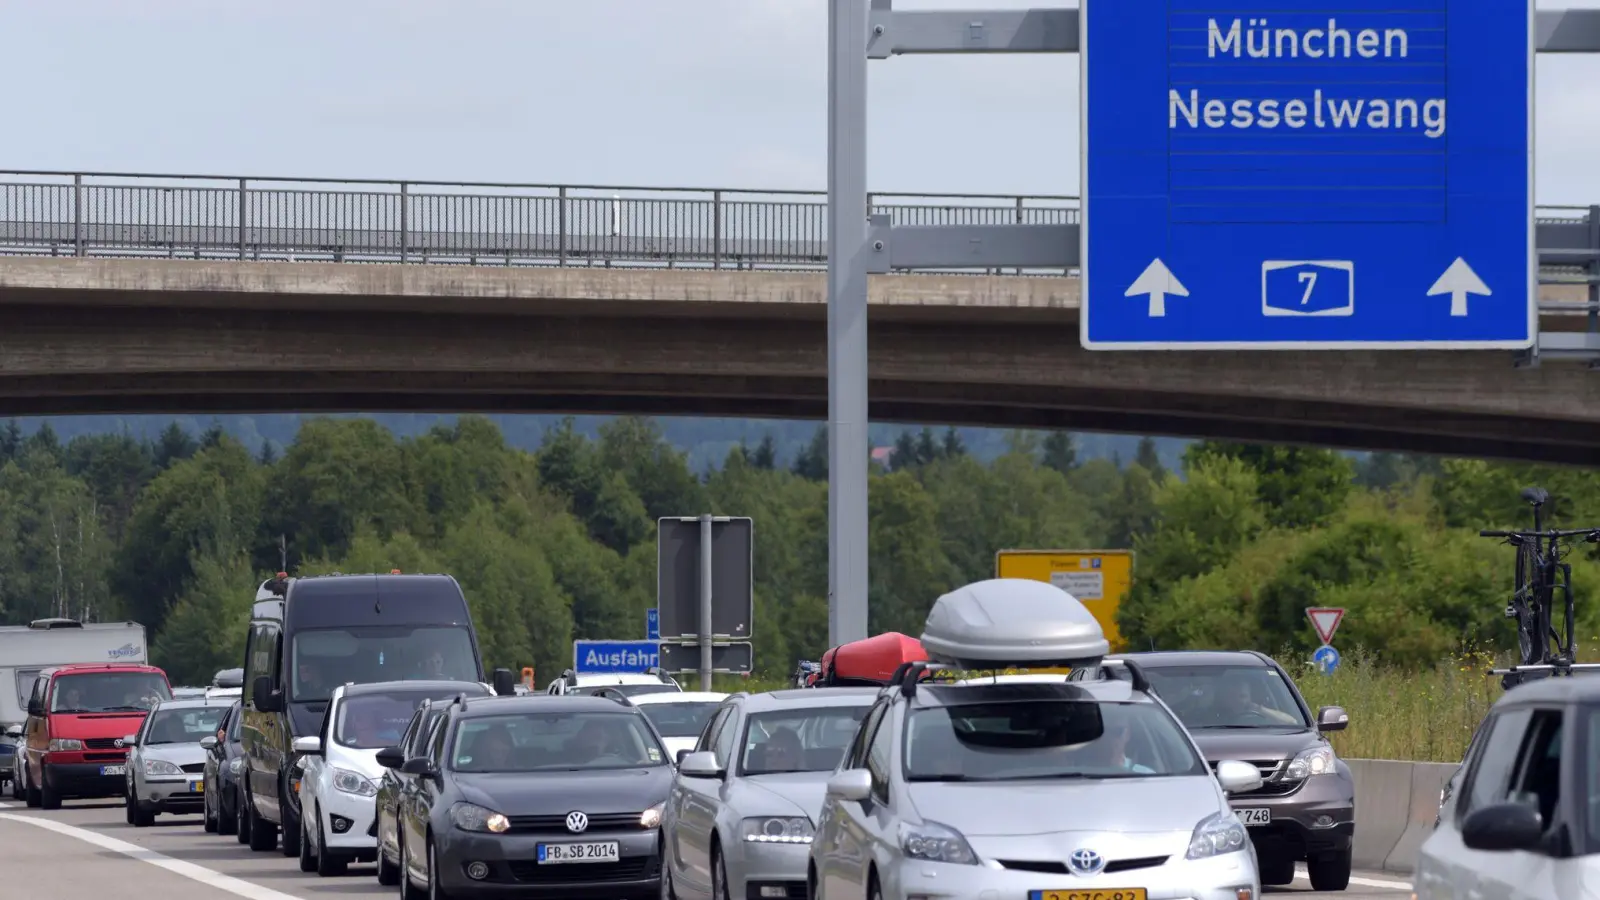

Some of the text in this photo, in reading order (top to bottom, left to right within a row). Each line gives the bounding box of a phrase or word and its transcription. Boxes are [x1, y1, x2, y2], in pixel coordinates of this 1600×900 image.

[1207, 18, 1409, 58] München
[1168, 88, 1447, 138] Nesselwang
[1298, 271, 1317, 305] 7
[586, 649, 658, 666] Ausfahr
[1245, 809, 1269, 822] 748
[570, 845, 584, 858] SB
[587, 844, 615, 857] 2014
